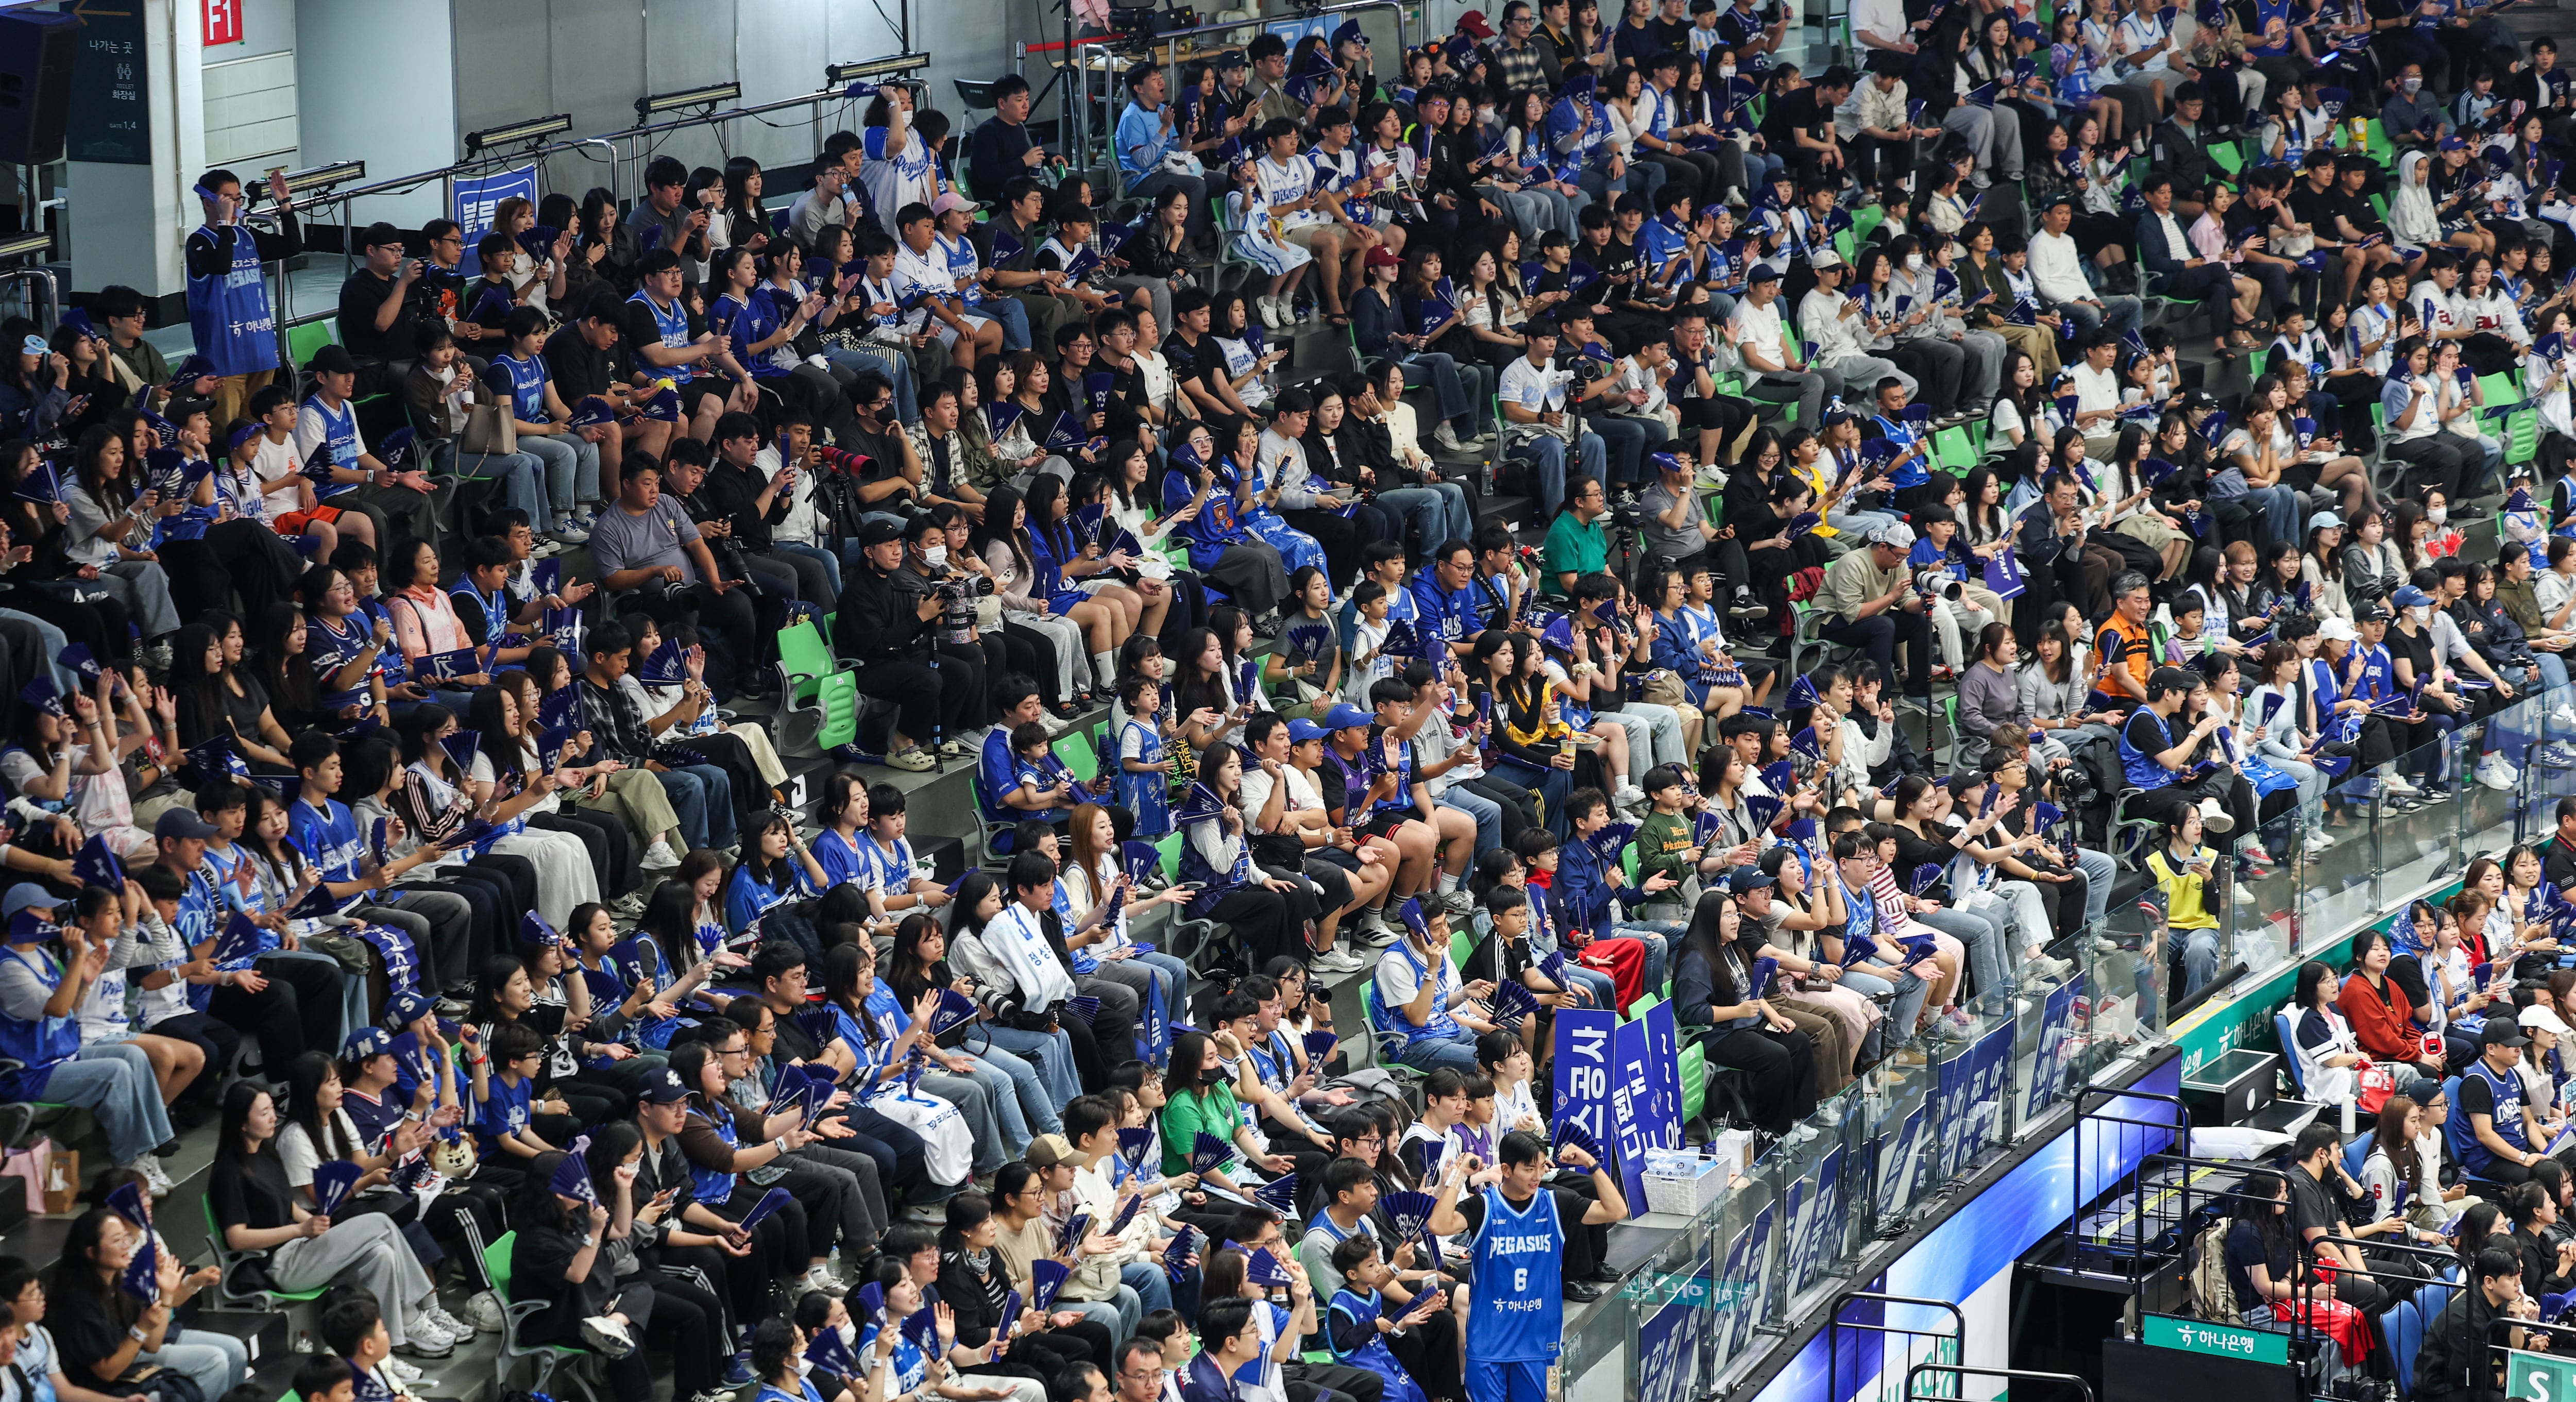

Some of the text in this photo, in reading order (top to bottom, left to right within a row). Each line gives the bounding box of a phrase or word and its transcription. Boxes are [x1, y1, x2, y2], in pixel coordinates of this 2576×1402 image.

[208, 0, 233, 41] F1
[89, 40, 133, 54] 나가는 곳
[112, 90, 136, 100] 화장실
[2180, 1047, 2203, 1078] 은행
[1570, 1025, 1607, 1145] 스공사
[1877, 1141, 1910, 1216] 벨란
[1489, 1233, 1551, 1259] PEGASUS
[1514, 1268, 1528, 1292] 6
[1508, 1298, 1542, 1312] 하나은행
[2198, 1331, 2255, 1354] 하나은행
[1657, 1319, 1683, 1398] 우혁
